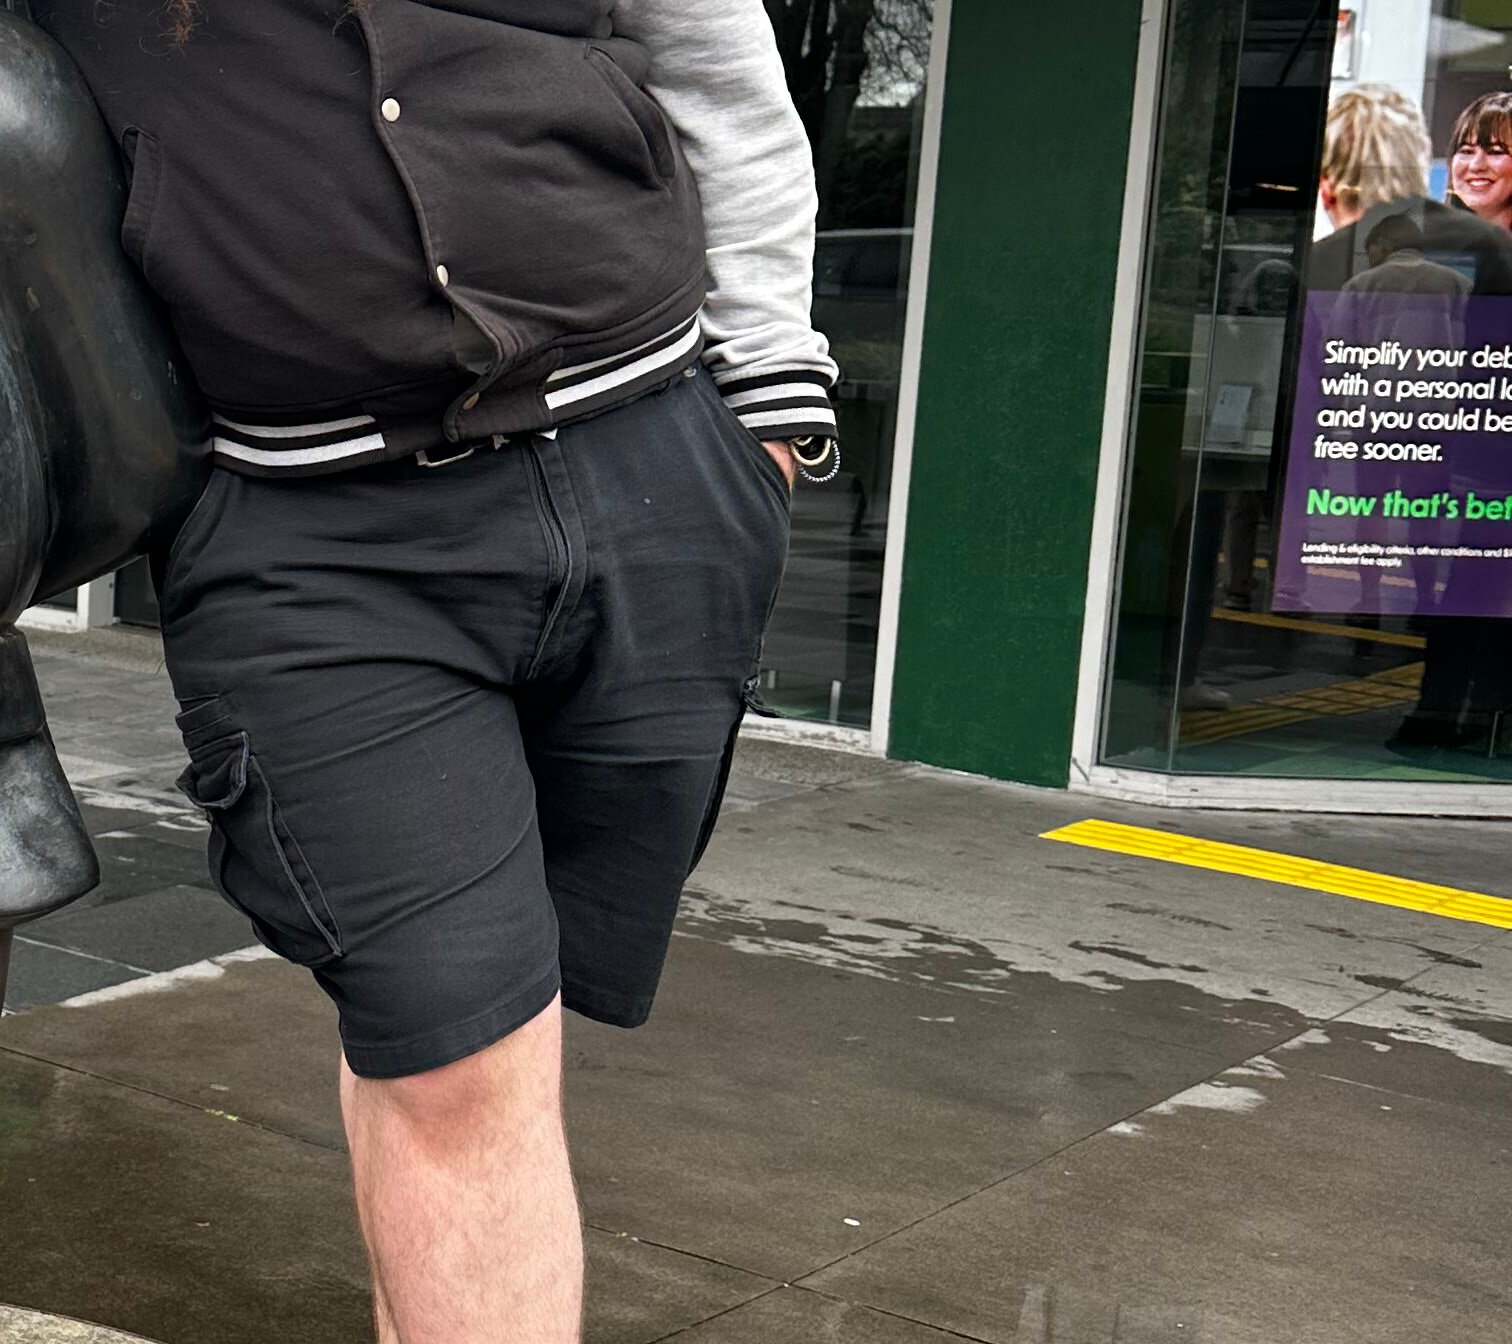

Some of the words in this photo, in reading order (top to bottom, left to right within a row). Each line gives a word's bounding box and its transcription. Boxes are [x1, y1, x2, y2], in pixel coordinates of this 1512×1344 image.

[1324, 340, 1412, 371] Simplify
[1416, 348, 1468, 371] your
[1321, 372, 1369, 396] with
[1373, 379, 1392, 397] a
[1396, 377, 1496, 402] personal
[1317, 404, 1366, 428] and
[1370, 411, 1413, 433] you
[1418, 408, 1480, 431] could
[1314, 434, 1359, 459] free
[1362, 442, 1443, 462] sooner.
[1306, 488, 1377, 517] Now
[1382, 490, 1459, 519] that's
